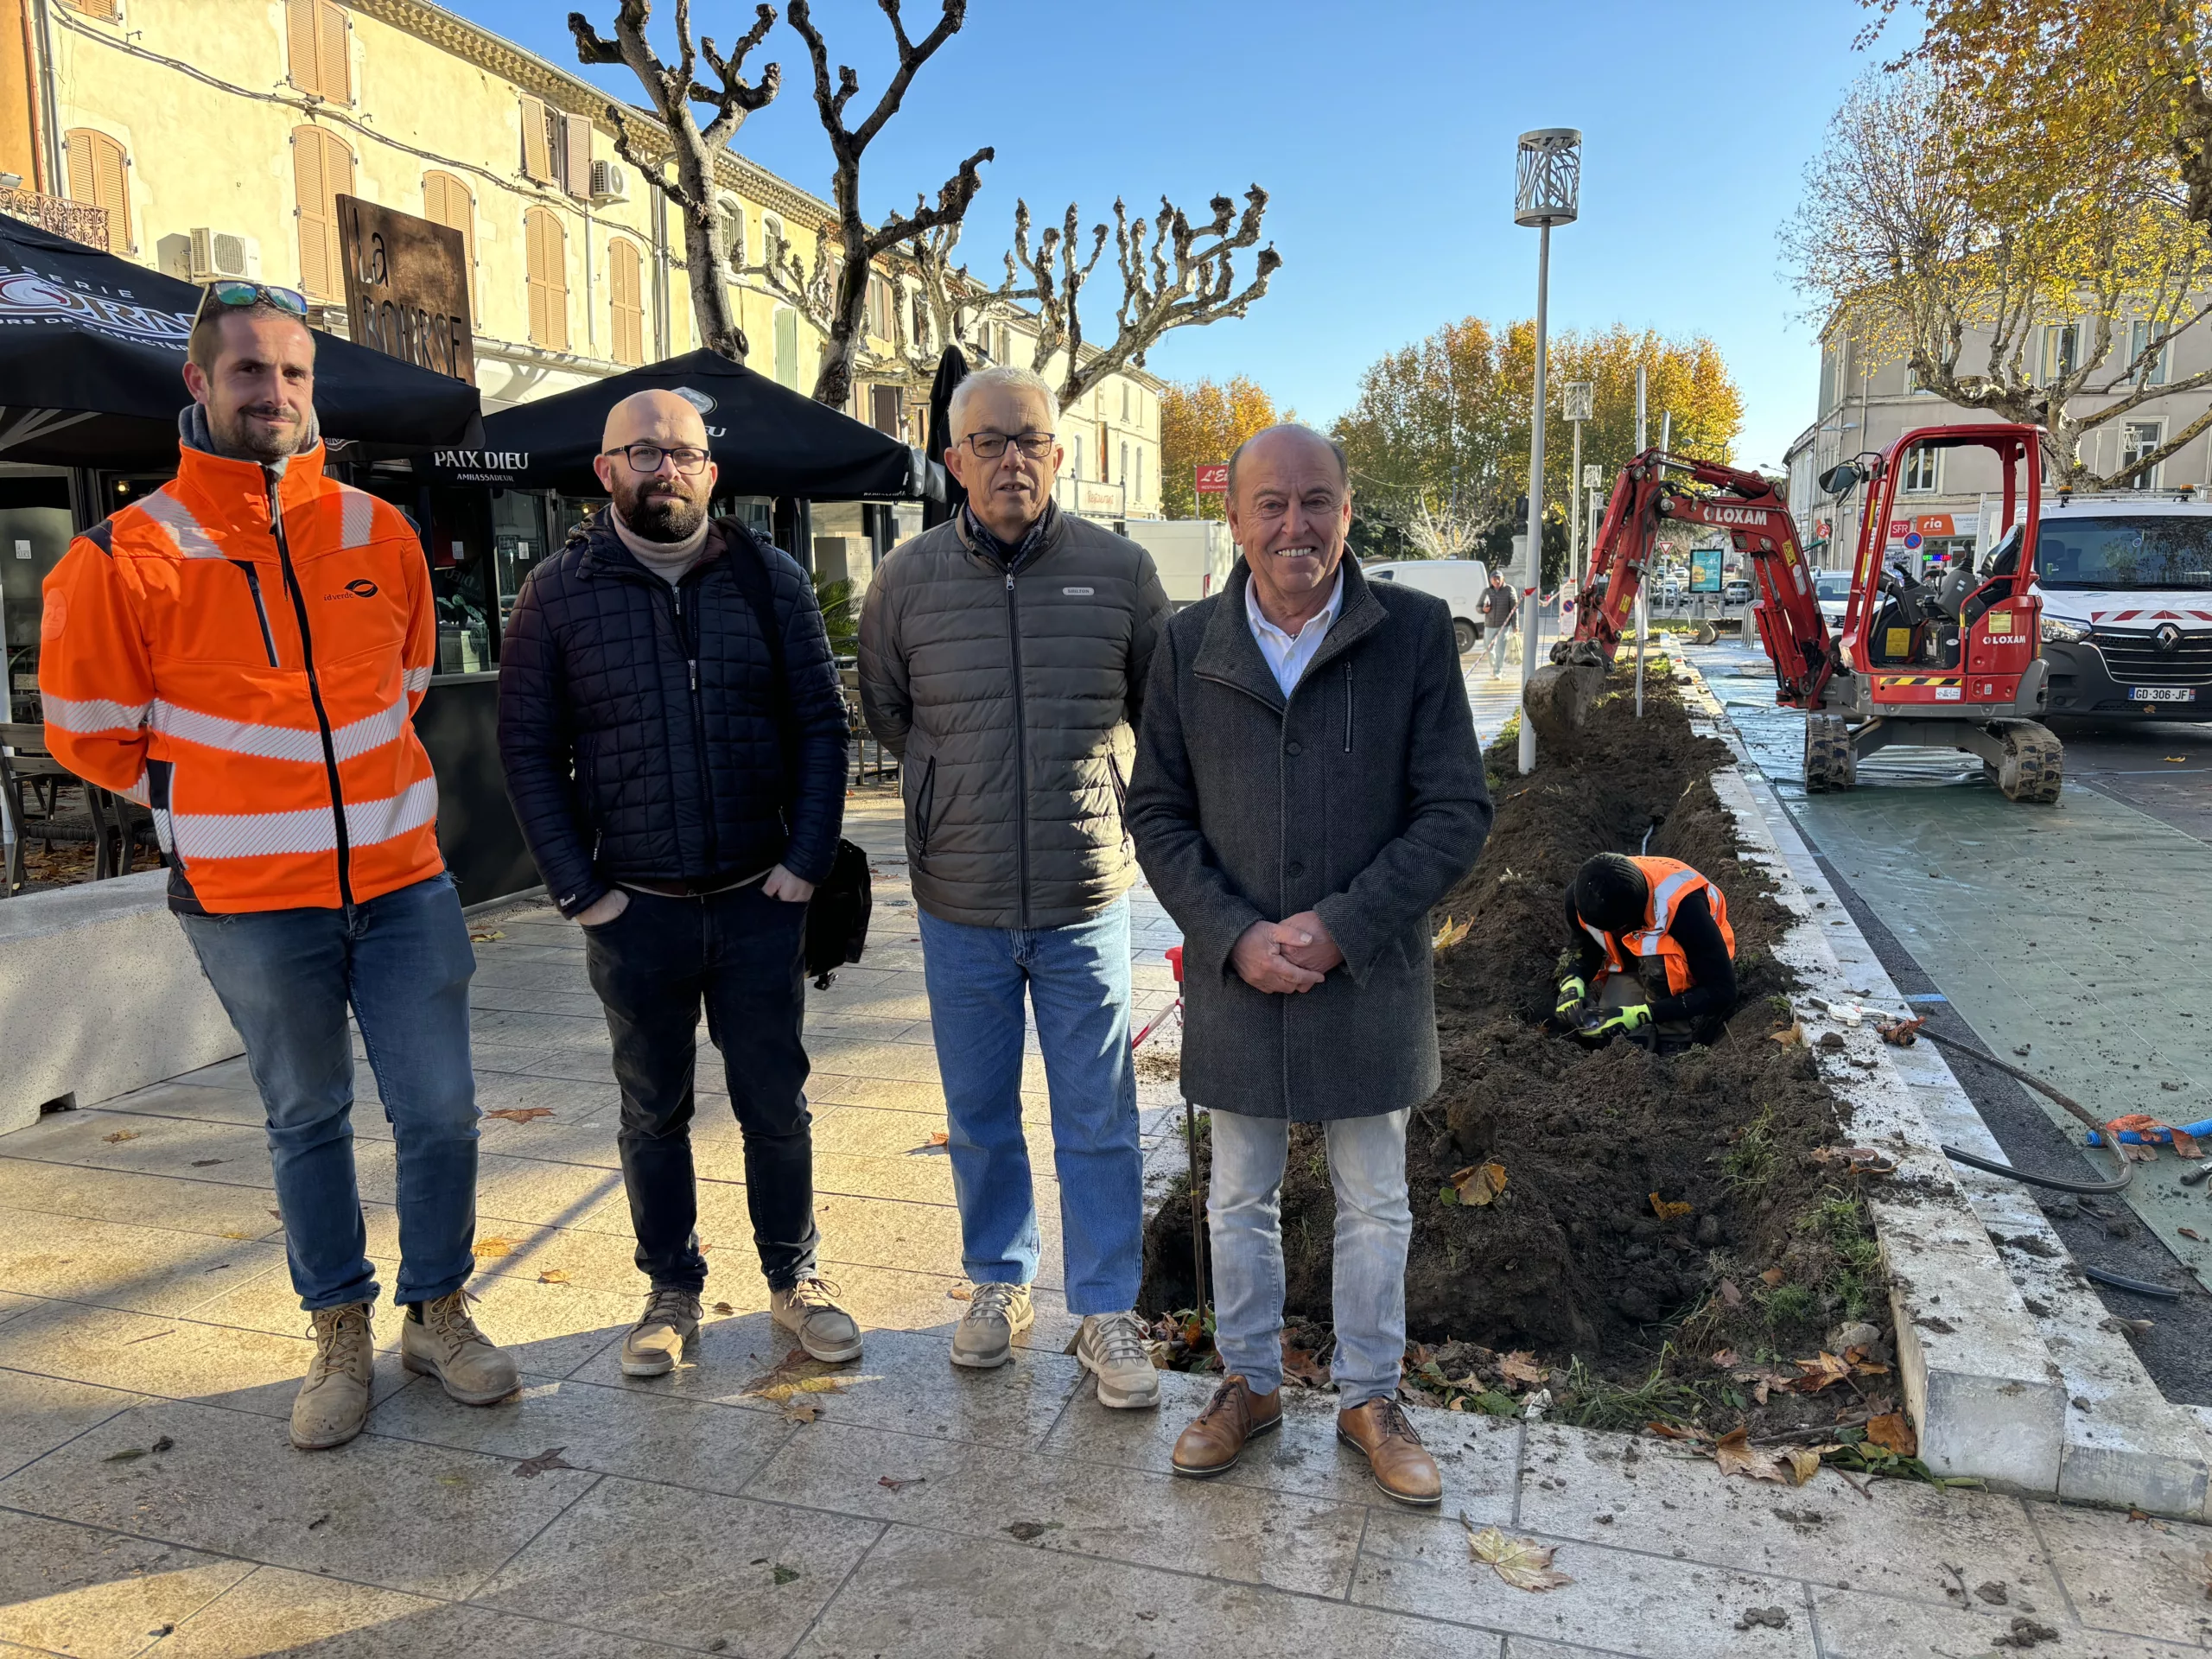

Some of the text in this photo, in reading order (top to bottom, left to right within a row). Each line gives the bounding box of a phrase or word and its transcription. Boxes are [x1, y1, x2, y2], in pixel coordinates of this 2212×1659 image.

[353, 207, 389, 288] La
[363, 295, 467, 383] BOURSE
[434, 450, 530, 469] PAIX DIEU
[456, 473, 515, 482] AMBASSADEUR
[1715, 507, 1768, 526] LOXAM
[1891, 524, 1909, 534] SFR
[1923, 518, 1942, 529] ria
[1993, 635, 2026, 645] LOXAM
[2135, 689, 2188, 700] GD-306-JF
